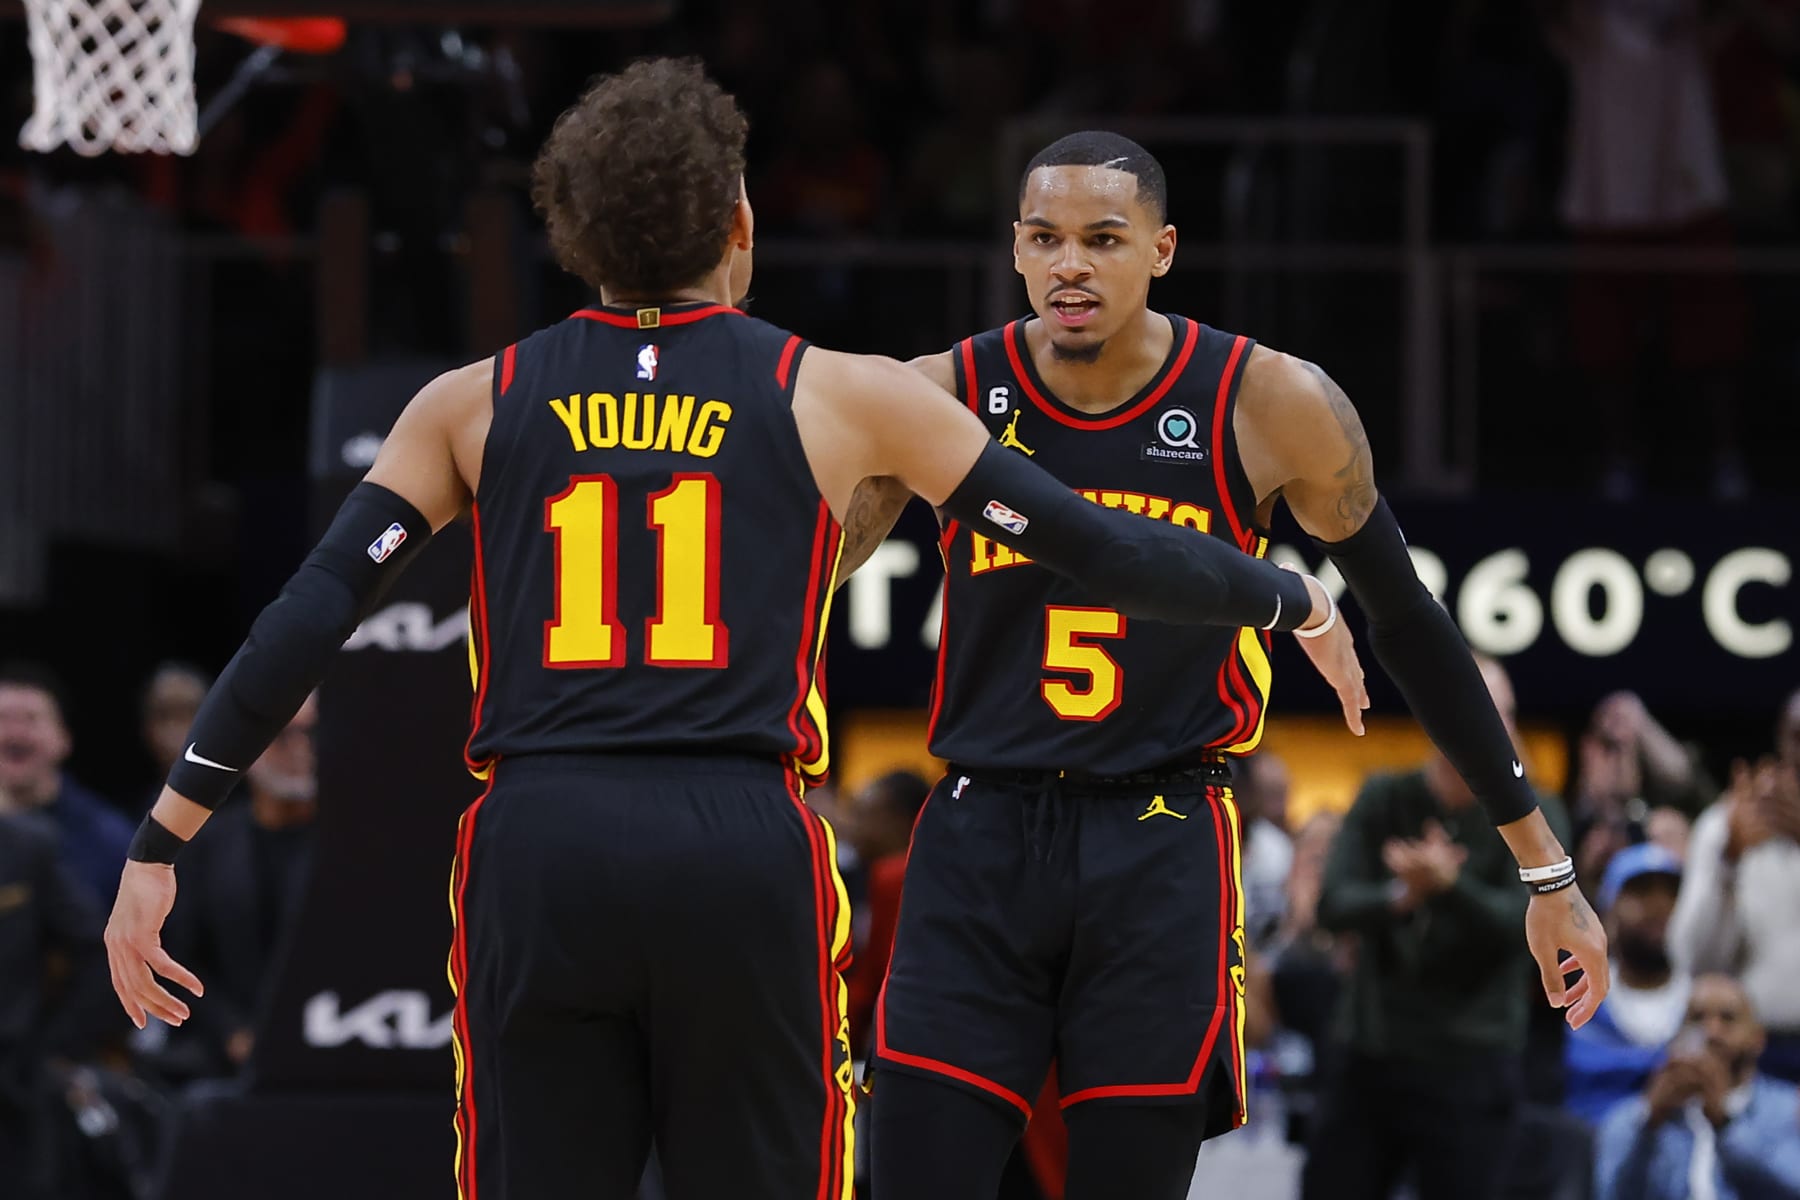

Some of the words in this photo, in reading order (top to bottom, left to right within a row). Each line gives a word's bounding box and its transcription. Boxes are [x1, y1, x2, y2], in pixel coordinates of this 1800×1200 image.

[548, 392, 733, 458] YOUNG
[988, 387, 1009, 414] 6
[1146, 446, 1204, 460] sharecare
[542, 472, 729, 669] 11
[1041, 604, 1127, 722] 5
